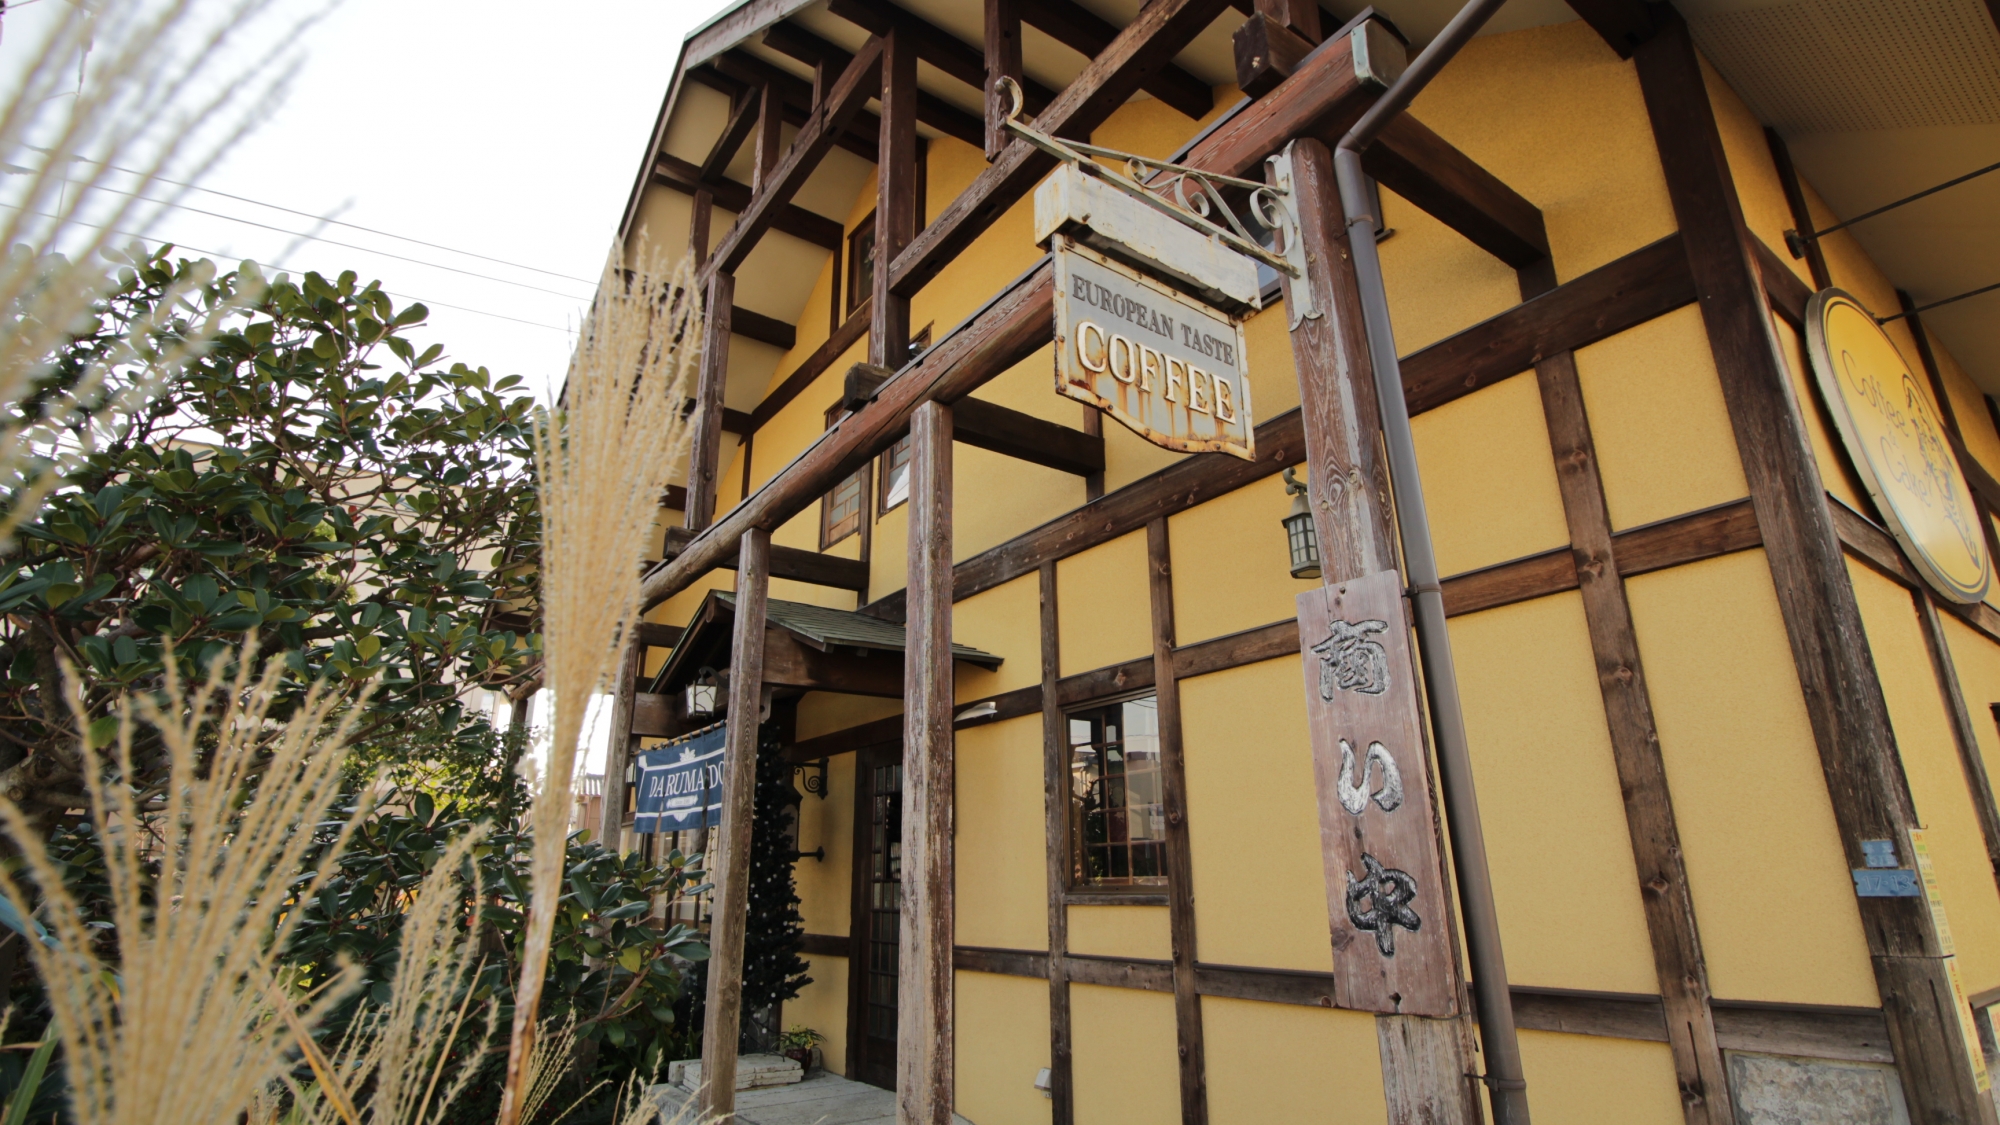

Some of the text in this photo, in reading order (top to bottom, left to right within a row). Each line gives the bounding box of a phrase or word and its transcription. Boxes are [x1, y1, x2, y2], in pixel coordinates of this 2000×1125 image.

[1072, 273, 1235, 367] EUROPEAN TASTE
[1076, 321, 1237, 425] COFFEE
[1841, 349, 1909, 438] Coffee
[1880, 435, 1932, 508] Cake
[1310, 619, 1422, 958] 商い中
